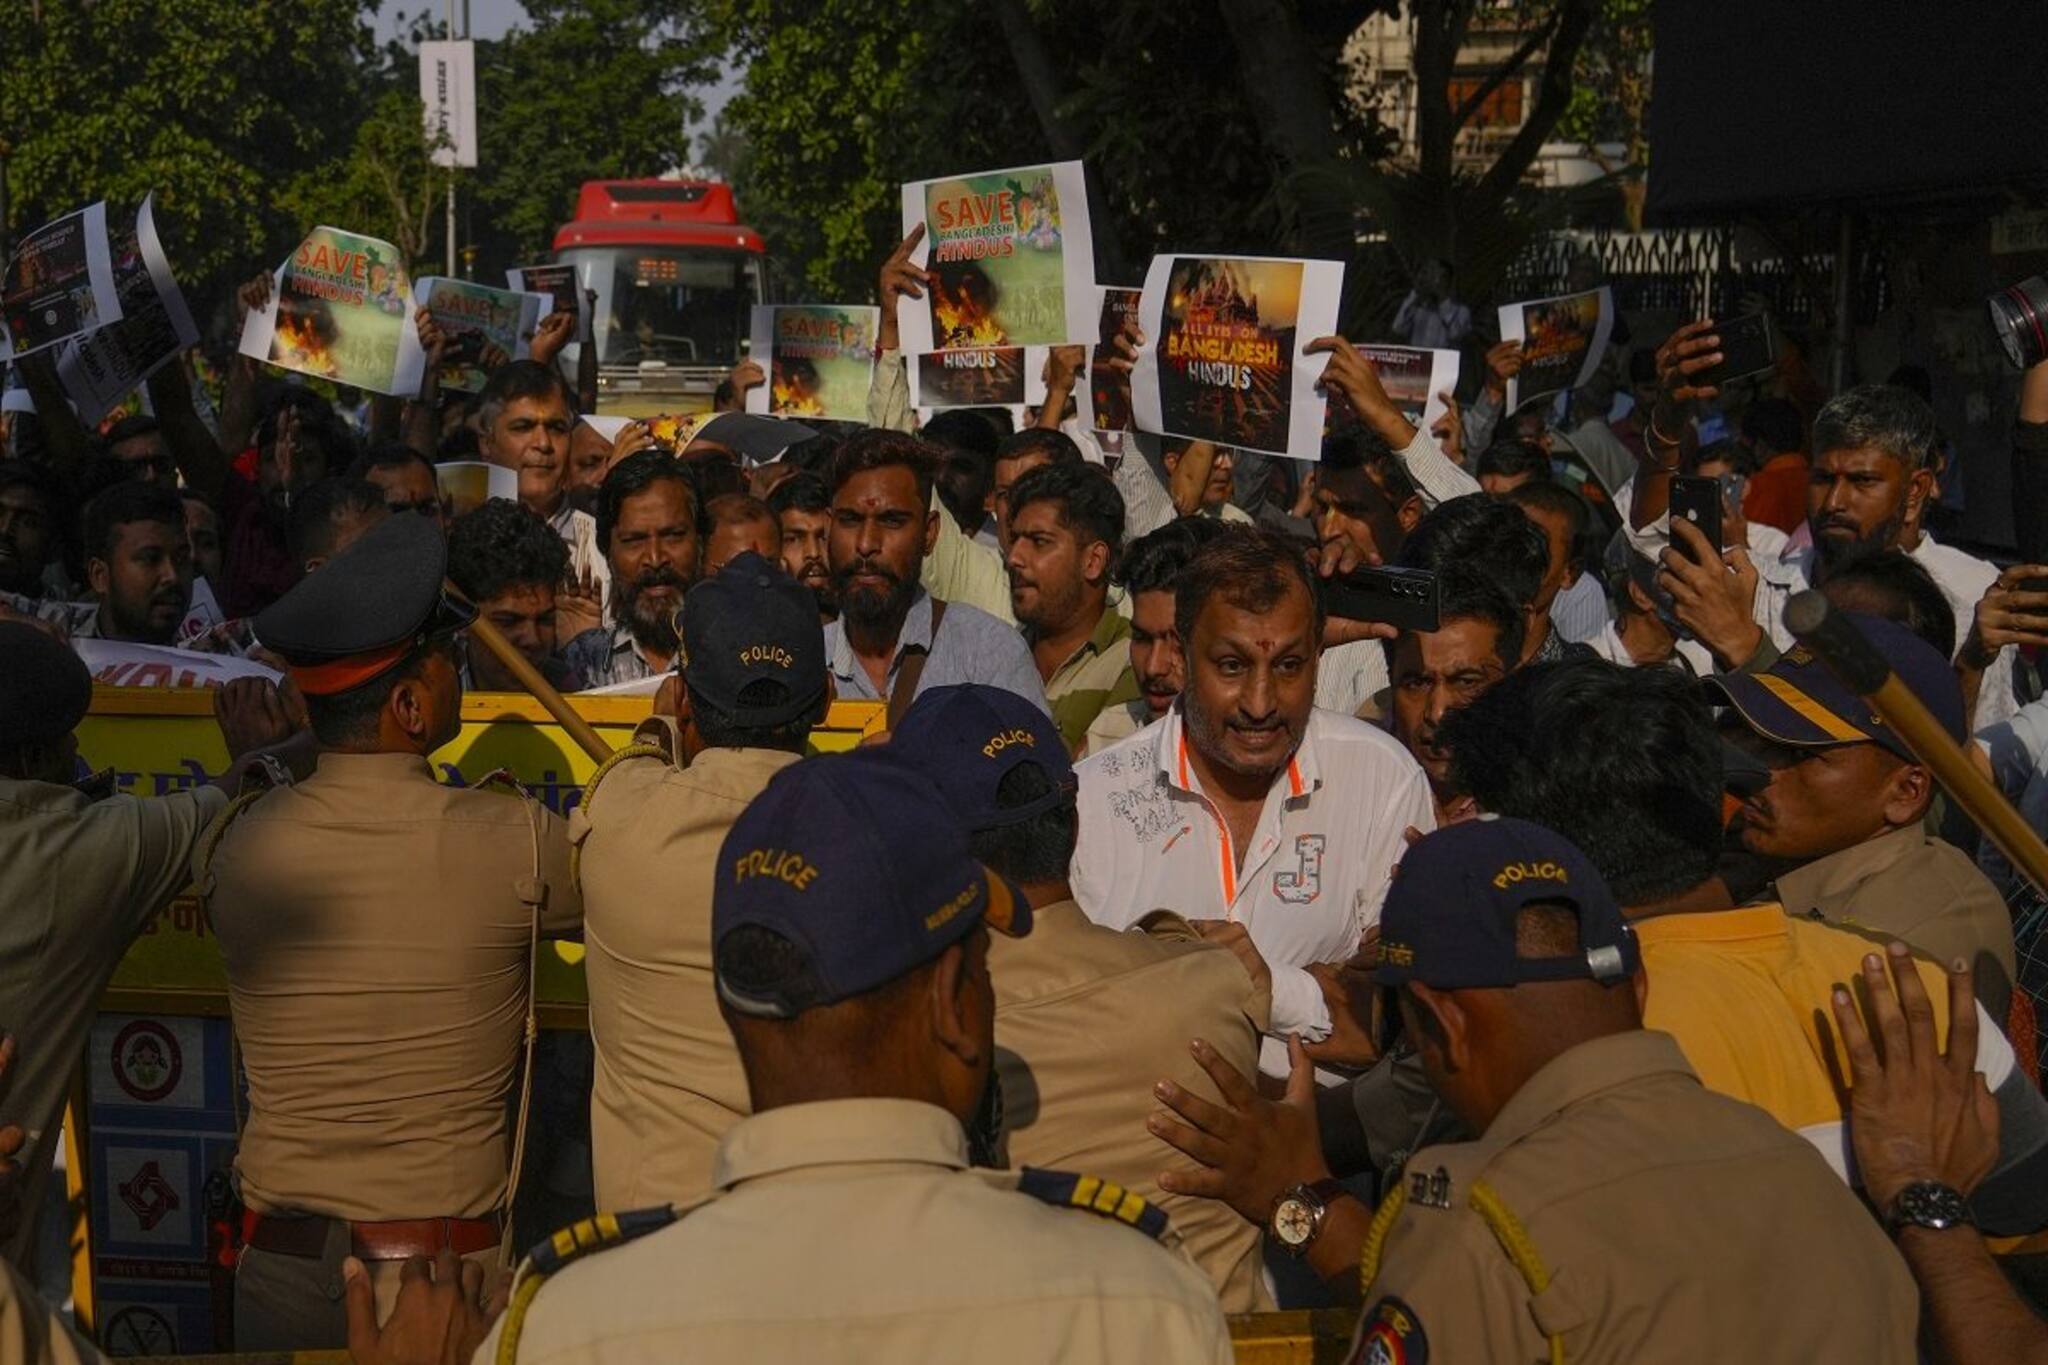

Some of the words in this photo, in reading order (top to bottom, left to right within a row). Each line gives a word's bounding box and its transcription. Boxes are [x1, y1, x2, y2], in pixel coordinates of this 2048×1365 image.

[937, 192, 1014, 229] SAVE
[297, 241, 367, 279] SAVE
[936, 236, 1014, 263] HINDUS
[292, 274, 364, 306] HINDUS
[436, 292, 490, 320] SAVE
[780, 318, 838, 337] SAVE
[1181, 323, 1203, 335] ALL
[1241, 327, 1259, 339] ON
[943, 351, 997, 369] HINDUS
[1167, 331, 1280, 366] BANGLADESH
[1187, 361, 1253, 390] HINDUS
[740, 645, 793, 669] POLICE
[982, 730, 1035, 758] POLICE
[736, 849, 819, 891] POLICE
[1274, 834, 1326, 904] J
[1493, 862, 1568, 889] POLICE
